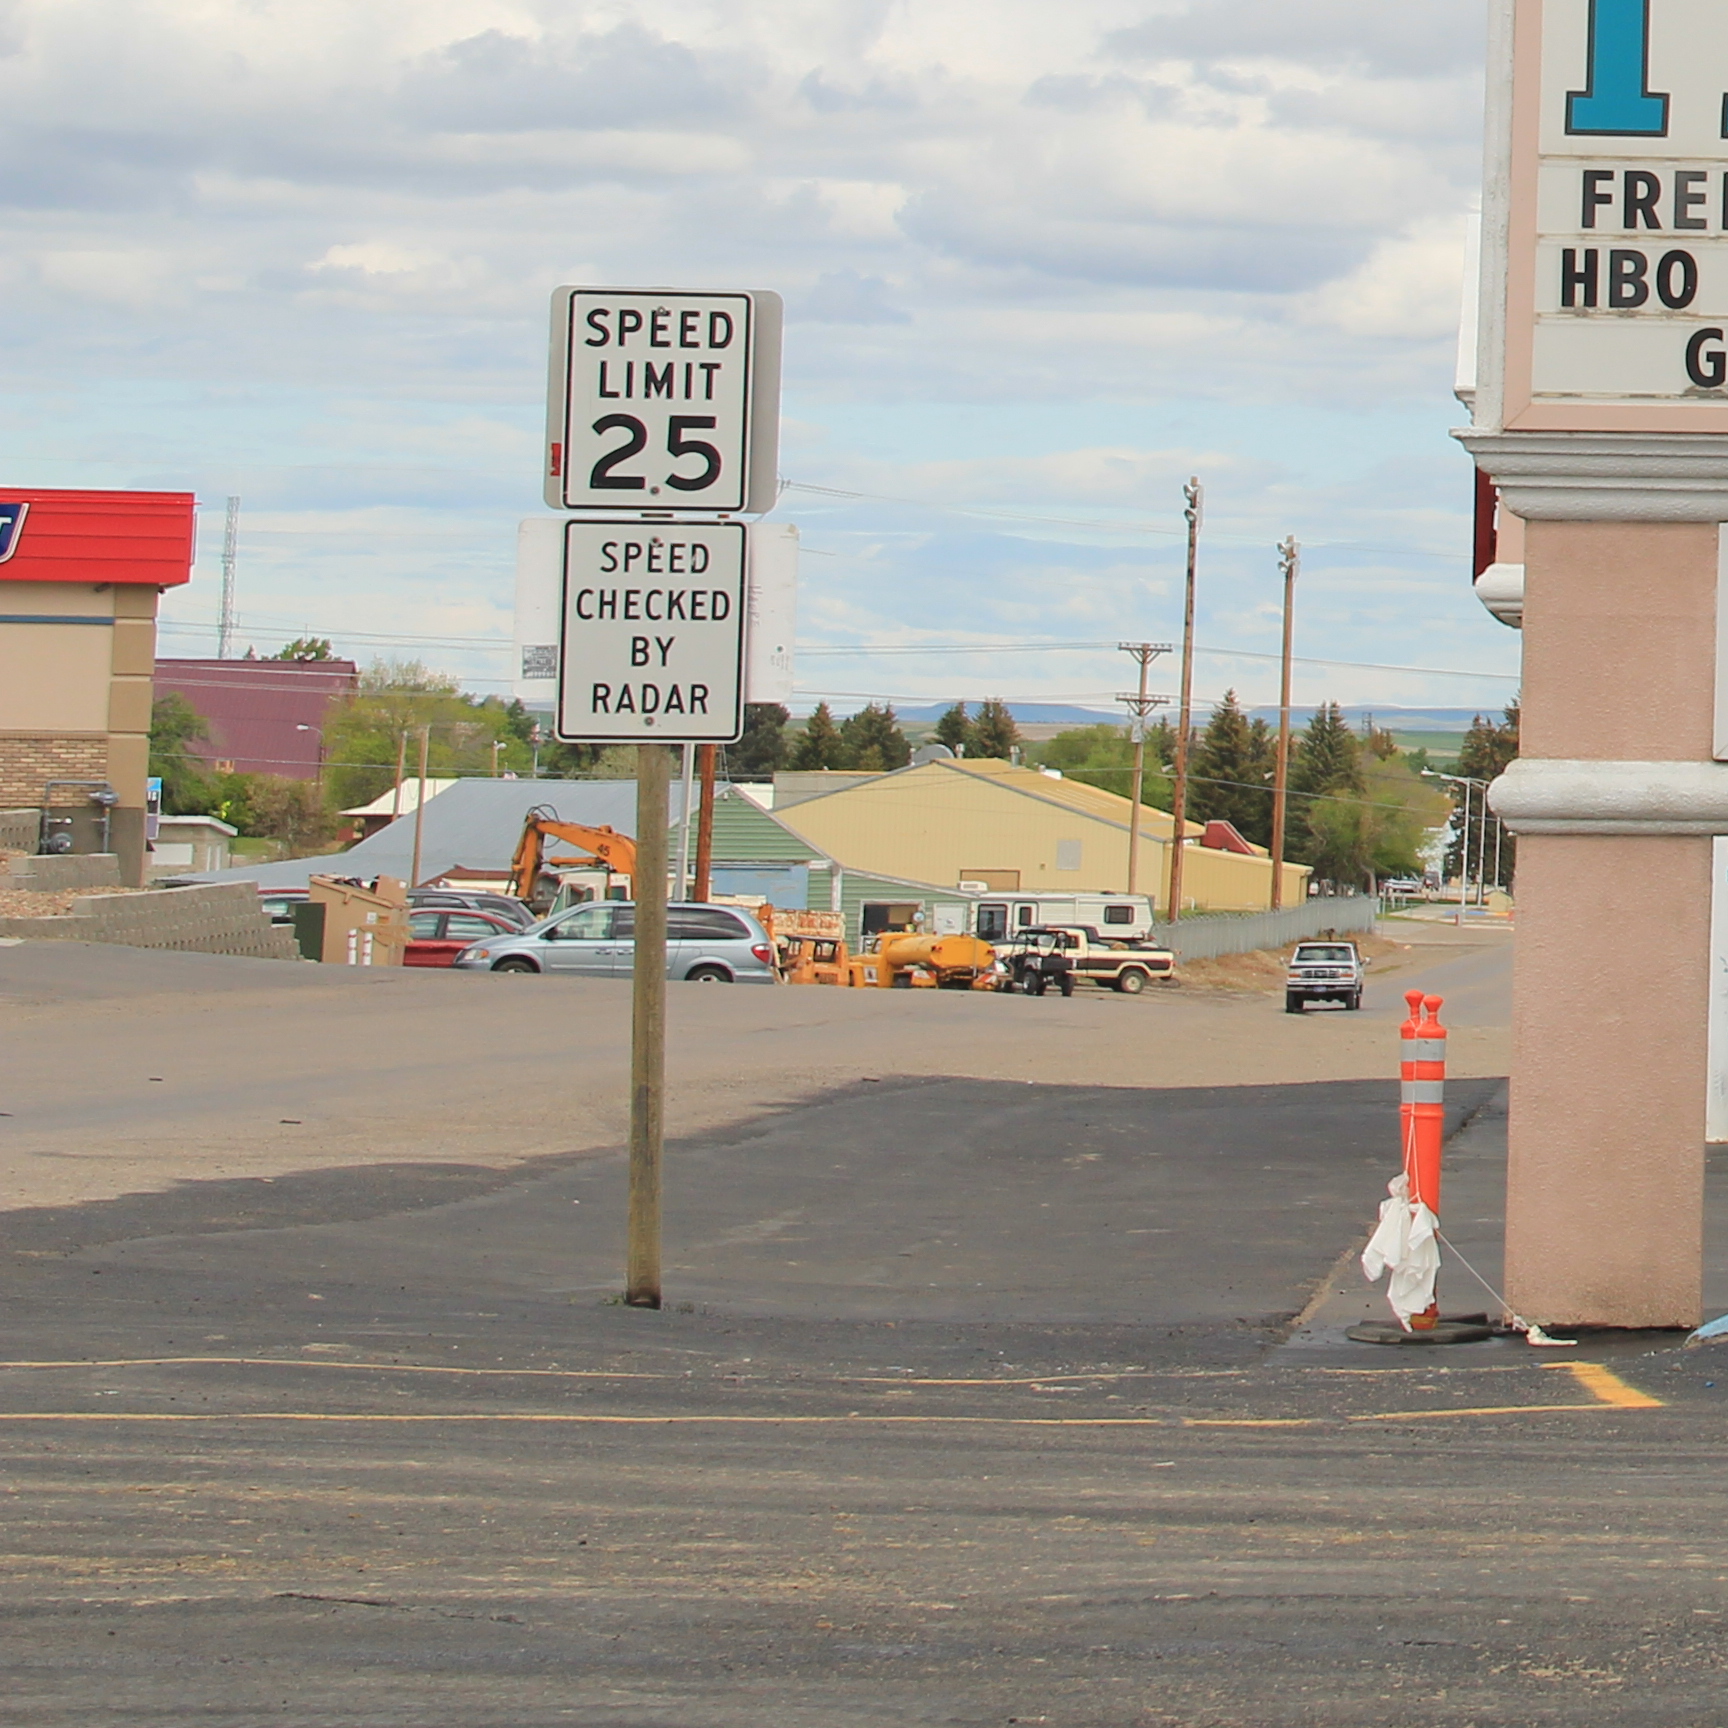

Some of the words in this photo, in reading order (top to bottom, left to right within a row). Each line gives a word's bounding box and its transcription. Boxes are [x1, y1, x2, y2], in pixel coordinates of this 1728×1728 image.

[1560, 247, 1698, 310] HBO
[585, 308, 733, 349] SPEED
[599, 360, 721, 400] LIMIT
[589, 413, 722, 491] 25
[600, 541, 710, 574] SPEED
[576, 588, 730, 622] CHECKED
[631, 636, 675, 668] BY
[592, 683, 710, 715] RADAR
